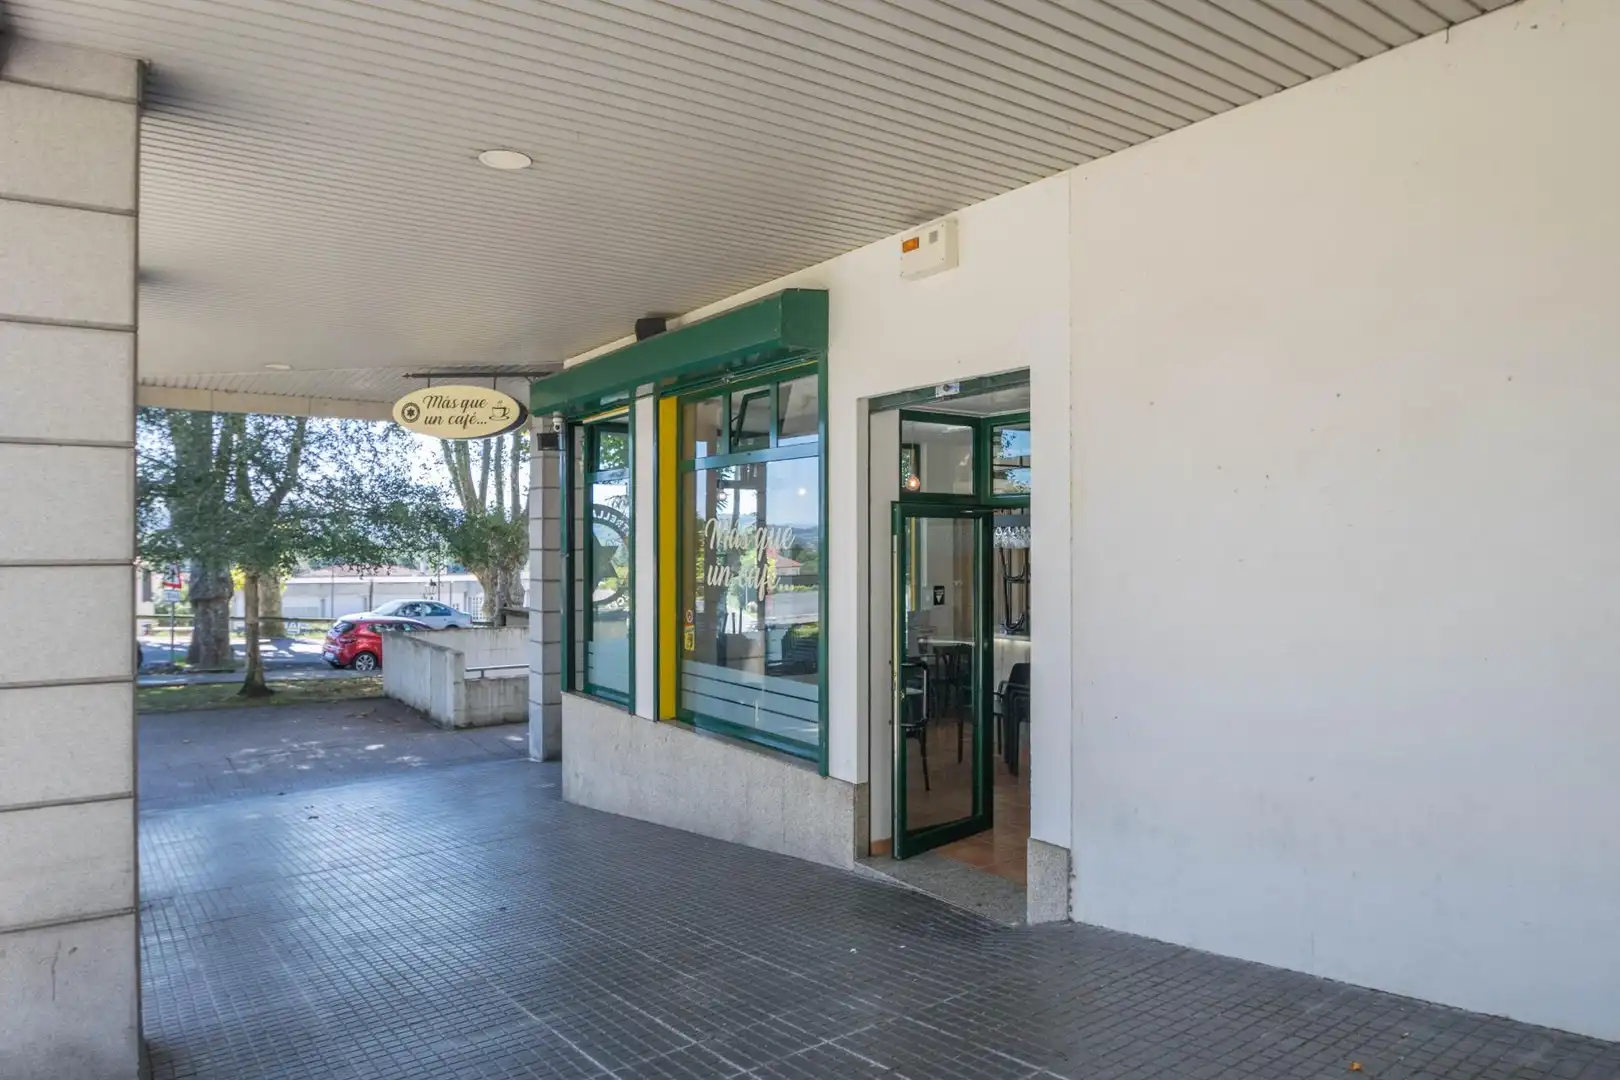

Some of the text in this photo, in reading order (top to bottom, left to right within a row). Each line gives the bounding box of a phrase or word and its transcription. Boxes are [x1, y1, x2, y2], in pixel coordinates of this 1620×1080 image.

[422, 395, 488, 413] Más que
[424, 411, 487, 430] un café...
[704, 517, 796, 562] Más que
[706, 564, 732, 588] un
